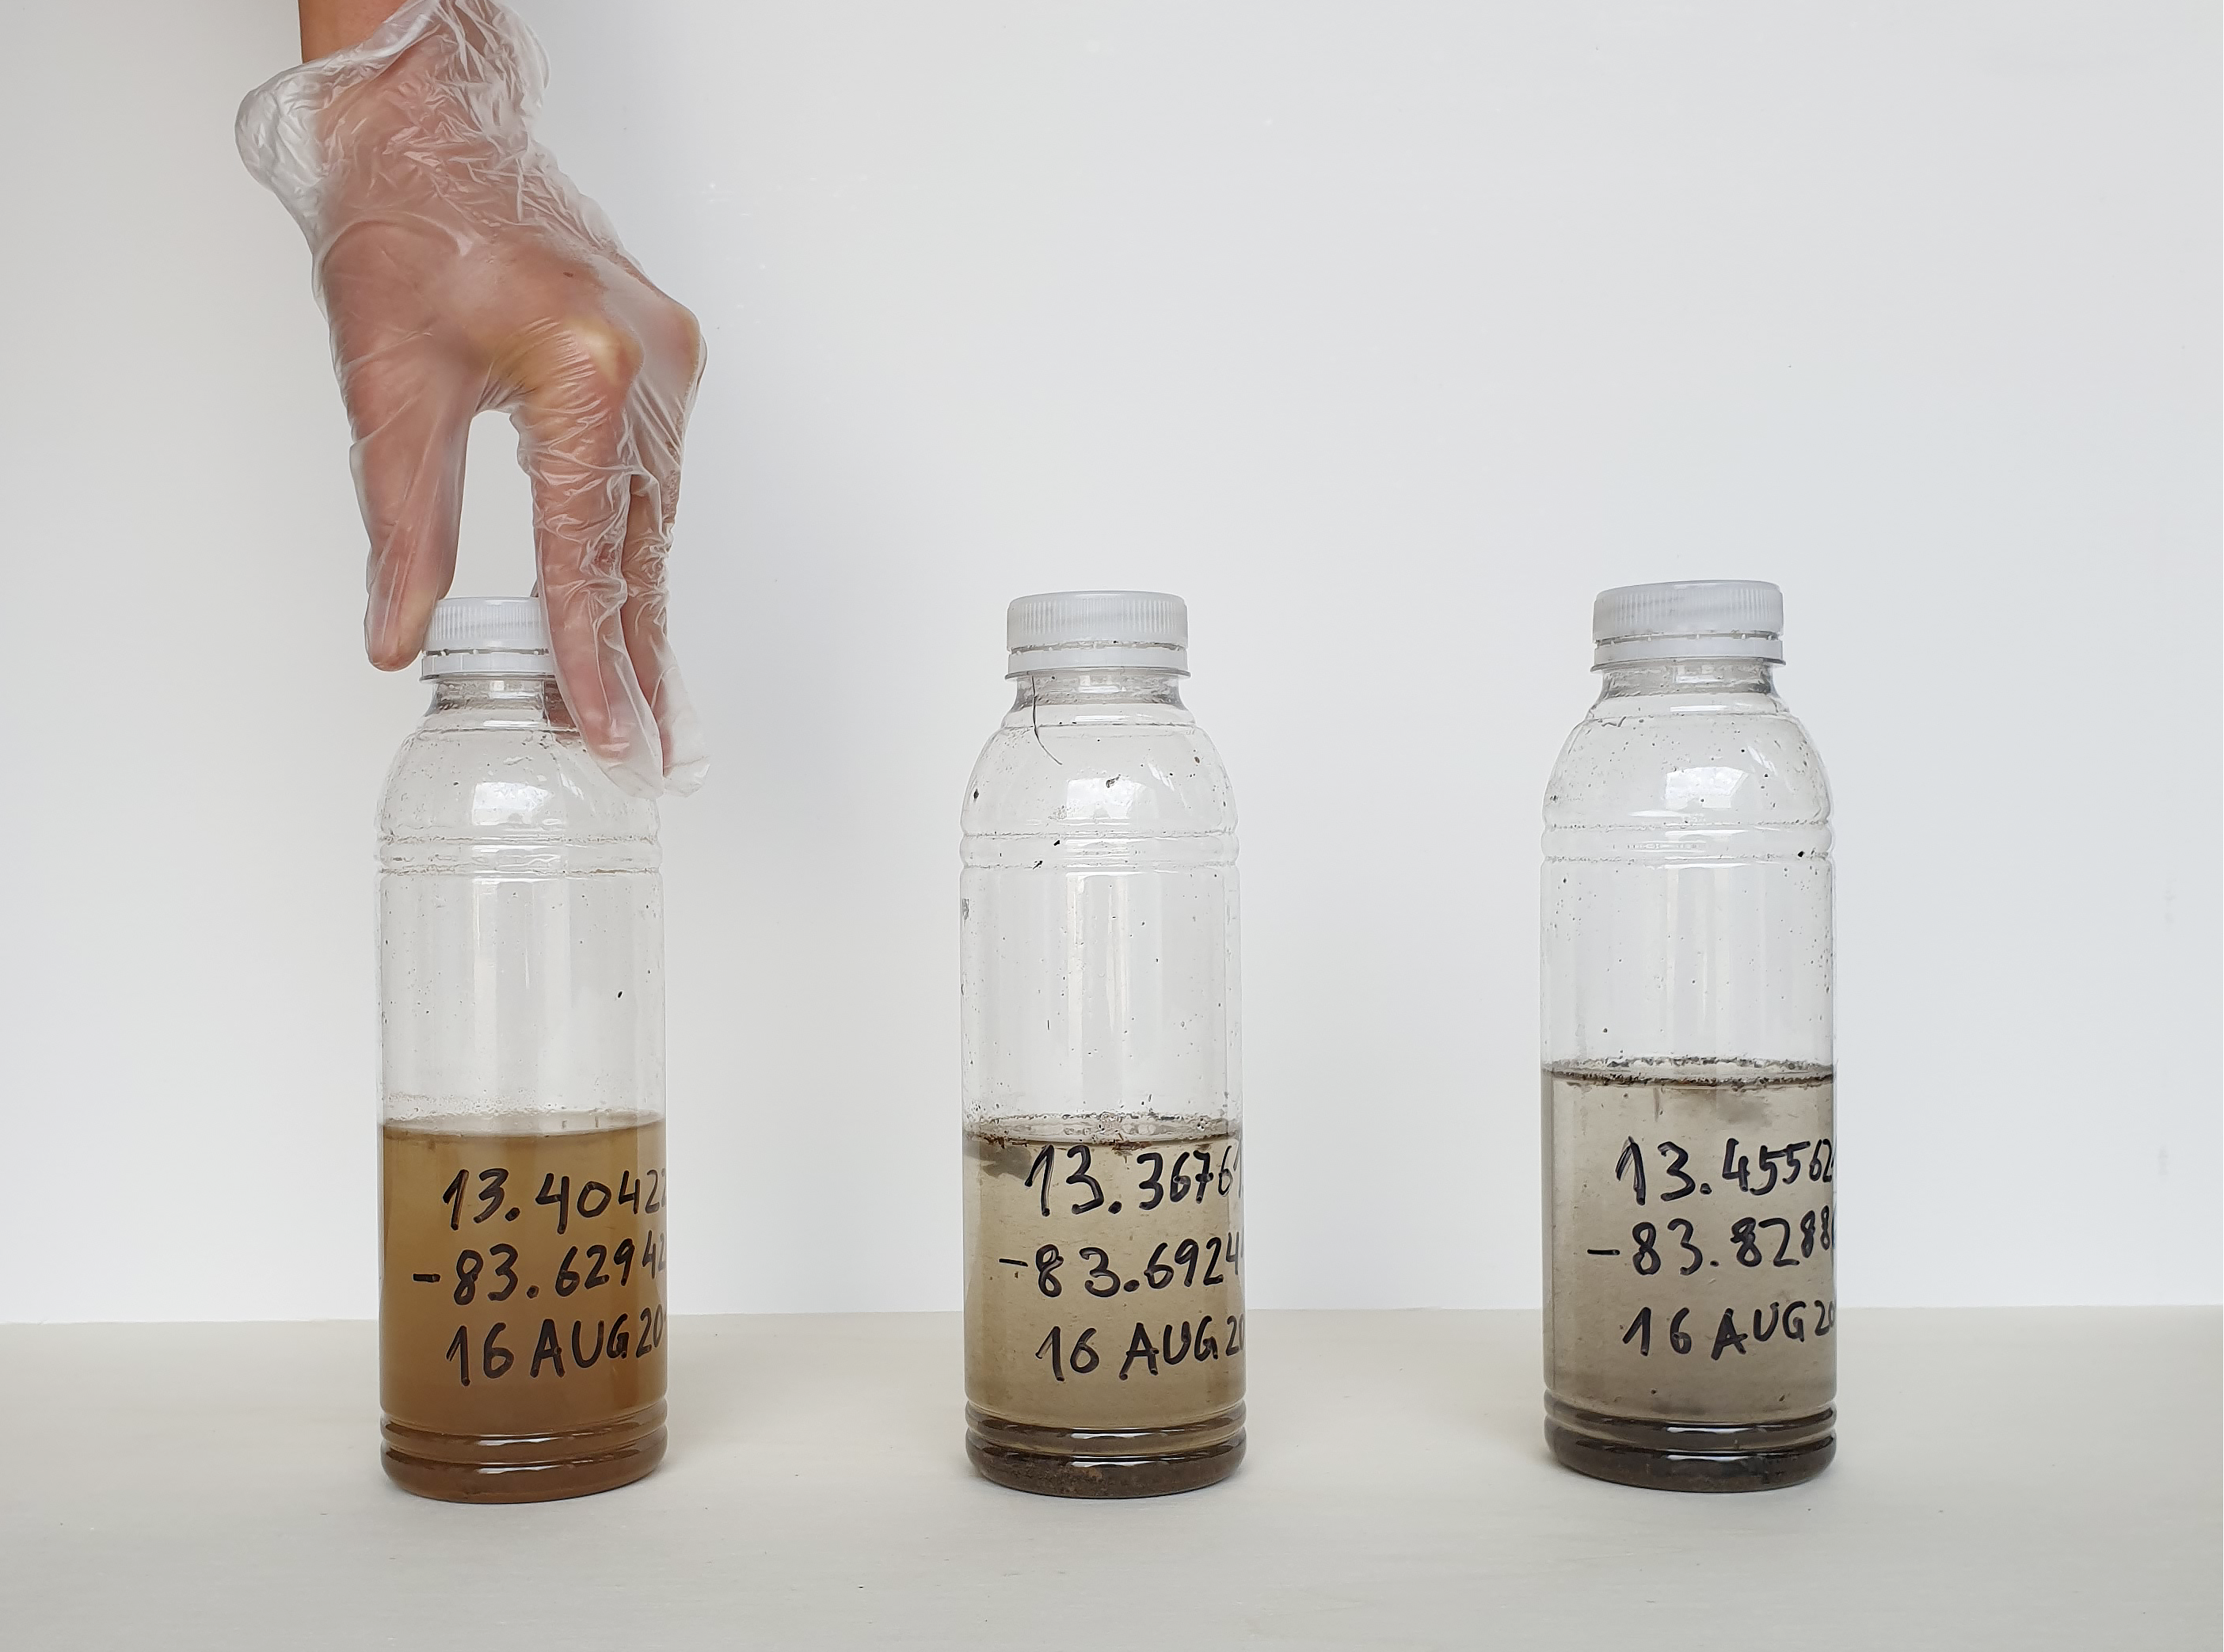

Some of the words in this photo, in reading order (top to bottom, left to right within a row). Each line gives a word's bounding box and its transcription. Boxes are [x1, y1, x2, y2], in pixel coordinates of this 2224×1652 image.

[446, 1322, 514, 1387] 16
[530, 1313, 630, 1379] AUG
[1035, 1326, 1099, 1381] 16
[1118, 1315, 1219, 1380] AUG
[1622, 1305, 1693, 1357] 16
[1710, 1300, 1805, 1361] AUG
